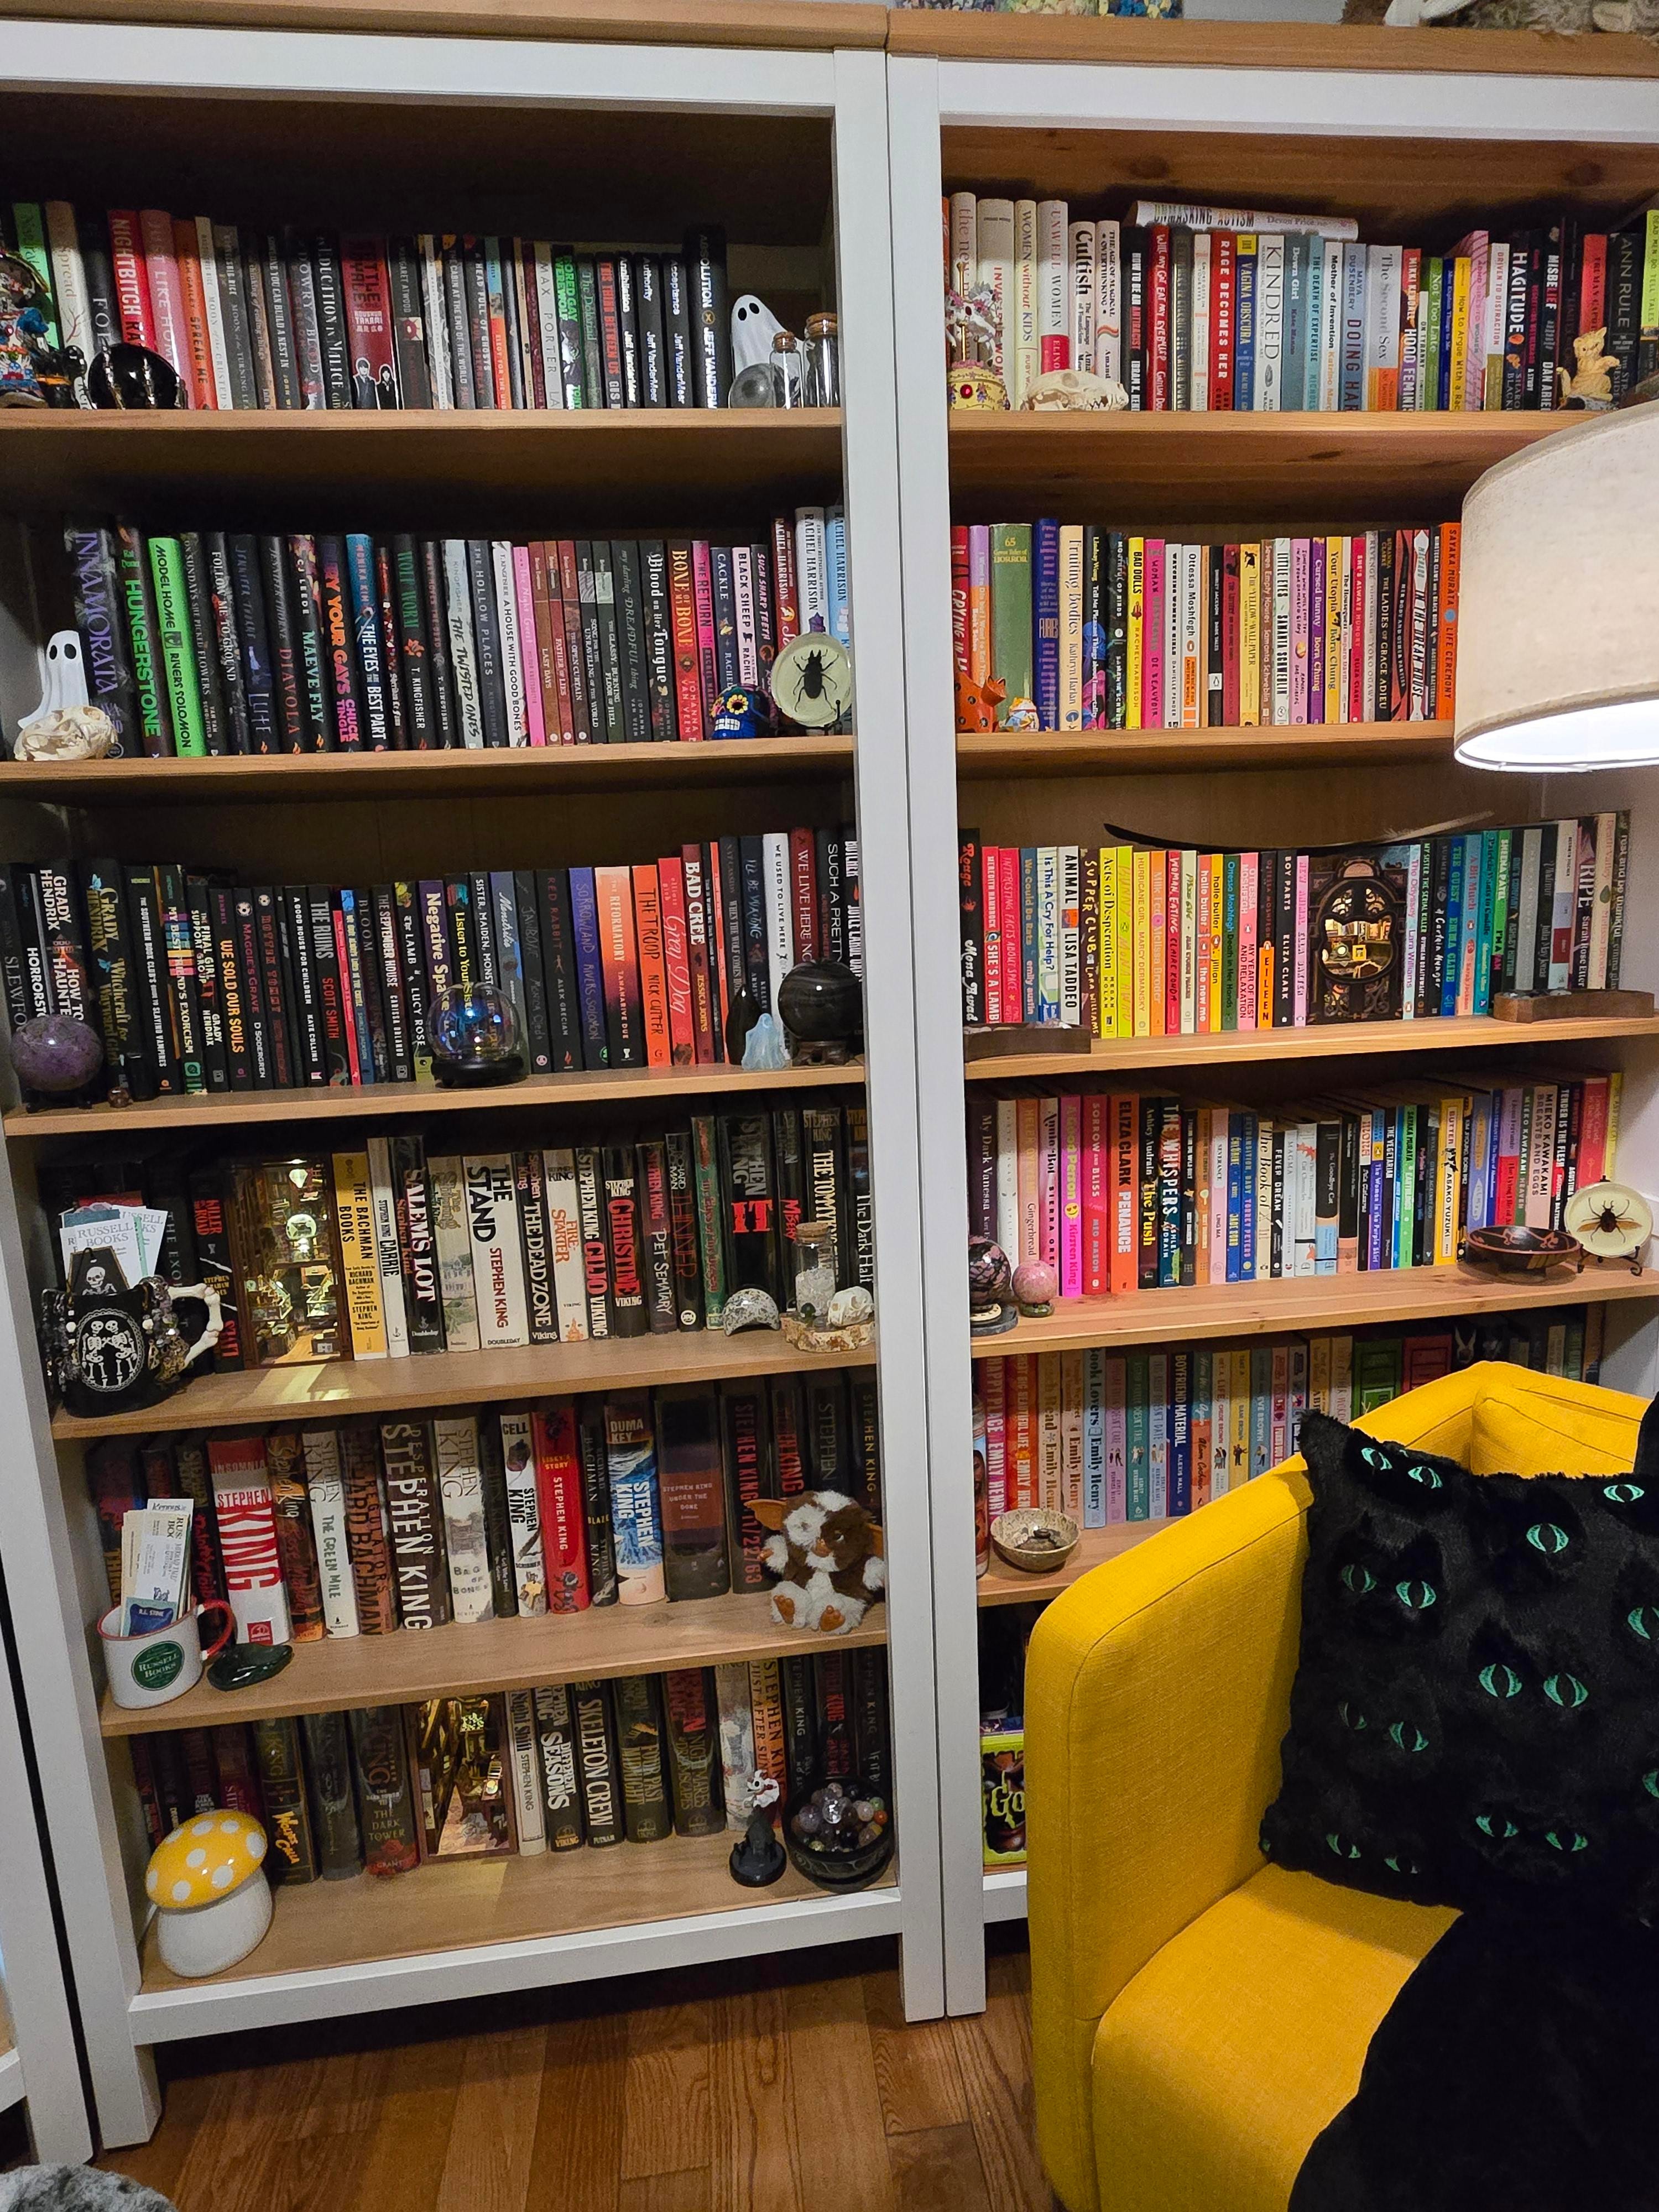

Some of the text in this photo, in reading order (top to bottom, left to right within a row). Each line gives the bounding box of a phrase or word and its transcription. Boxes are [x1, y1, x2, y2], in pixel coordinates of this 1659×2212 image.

[113, 220, 142, 316] NIGHTBITCH
[1021, 210, 1034, 342] WOMEN without KIDS
[1050, 210, 1062, 327] UNWELL WOMEN
[1075, 230, 1092, 295] Cultish
[1291, 247, 1300, 300] Down Girl
[1509, 252, 1528, 333] HAGITUDE
[539, 262, 557, 374] MAX PORTER
[1218, 240, 1229, 379] RAGE BECOMES HER
[1240, 262, 1253, 345] VAGINA OBSCURA
[1264, 246, 1282, 360] KINDRED
[1345, 319, 1361, 372] DOING
[155, 544, 176, 629] MODEL HOME
[648, 554, 664, 597] Blood
[672, 550, 690, 593] BONE
[717, 554, 728, 600] CACKLE
[738, 553, 751, 628] BLACK SHEEP
[805, 514, 818, 611] RACHEL HARRISON
[1067, 540, 1082, 635] Fruiting Bodies
[1133, 552, 1143, 594] BAD DOLLS
[75, 532, 118, 695] INNAMORATA
[474, 570, 489, 621] HOLLOW
[1187, 553, 1197, 636] Ottessa Moshfegh
[124, 580, 161, 738] HUNGERSTONE
[326, 596, 351, 695] YOUR GAYS
[363, 647, 379, 674] EYES
[504, 611, 522, 731] HOUSE WITH GOOD BONES
[1443, 650, 1453, 700] CEREMONY
[170, 653, 192, 748] RIVERS SOLOMON
[279, 648, 301, 735] DIAVOLA
[302, 631, 325, 723] MAEVE FLY
[413, 677, 425, 729] KINGFISHER
[336, 699, 349, 742] TINGLE
[346, 699, 359, 742] CHUCK
[367, 686, 386, 740] BEST PART
[828, 844, 839, 887] SUCH
[1578, 864, 1594, 908] RIPE
[40, 870, 60, 930] HENDRIX
[53, 876, 71, 924] GRADY
[426, 893, 443, 961] Negative
[609, 895, 625, 962] REFORMATORY
[685, 862, 706, 945] BAD CREE
[1042, 902, 1054, 920] Cry
[1083, 860, 1099, 953] SUPPER CLUB
[311, 902, 333, 959] THE RUINS
[986, 946, 998, 974] SHE'S
[1044, 943, 1055, 971] Help?
[1065, 854, 1077, 1009] ANIMAL LISA TADDEO
[170, 924, 194, 1053] BEST EXORCISM
[405, 933, 425, 1046] LAMB LUCY ROSE
[638, 889, 664, 1035] THE TROOP CUTTER
[220, 940, 244, 1053] WE SOLD OUR SOULS
[491, 1166, 513, 1203] THE
[1118, 1101, 1131, 1253] ELIZA CLARK PENANCE
[1163, 1104, 1179, 1216] THE WHISPERS
[354, 1182, 367, 1202] THE
[467, 1166, 497, 1243] STAND
[732, 1199, 773, 1233] IT
[77, 1222, 134, 1238] RUSSELL
[86, 1233, 129, 1246] BOOKS
[338, 1206, 354, 1243] BOOKS
[356, 1207, 374, 1260] BACHMAN
[551, 1209, 570, 1262] STARTER
[608, 1199, 641, 1296] CHRISTINE
[1143, 1213, 1155, 1246] Push
[379, 1240, 400, 1278] CARRIE
[489, 1248, 508, 1328] STEPHEN KING
[524, 1202, 552, 1327] THE DEAD ZONE
[651, 1229, 672, 1314] PET SEMATARY
[591, 1296, 608, 1336] VIKING
[615, 1296, 641, 1307] VIKING
[532, 1332, 557, 1340] Viking
[502, 1423, 529, 1435] CELL
[610, 1420, 644, 1432] DUMA
[611, 1432, 633, 1443] KEY
[1174, 1405, 1186, 1447] MATERIAL
[217, 1488, 272, 1507] STEPHEN
[615, 1484, 634, 1519] KING
[1088, 1438, 1102, 1510] Emily Henry
[382, 1424, 432, 1630] STEPHEN KING
[508, 1489, 525, 1524] KING
[523, 1488, 538, 1532] STEPHEN
[554, 1477, 568, 1551] STEPHEN KING
[634, 1481, 655, 1548] STEPHEN
[216, 1509, 281, 1592] KING
[138, 1653, 179, 1672] RUSSELL
[145, 1662, 177, 1677] BOOKS
[521, 1755, 534, 1811] STEPHEN KING
[541, 1731, 570, 1809] SEASONS
[578, 1699, 613, 1826] SKELETON CREW
